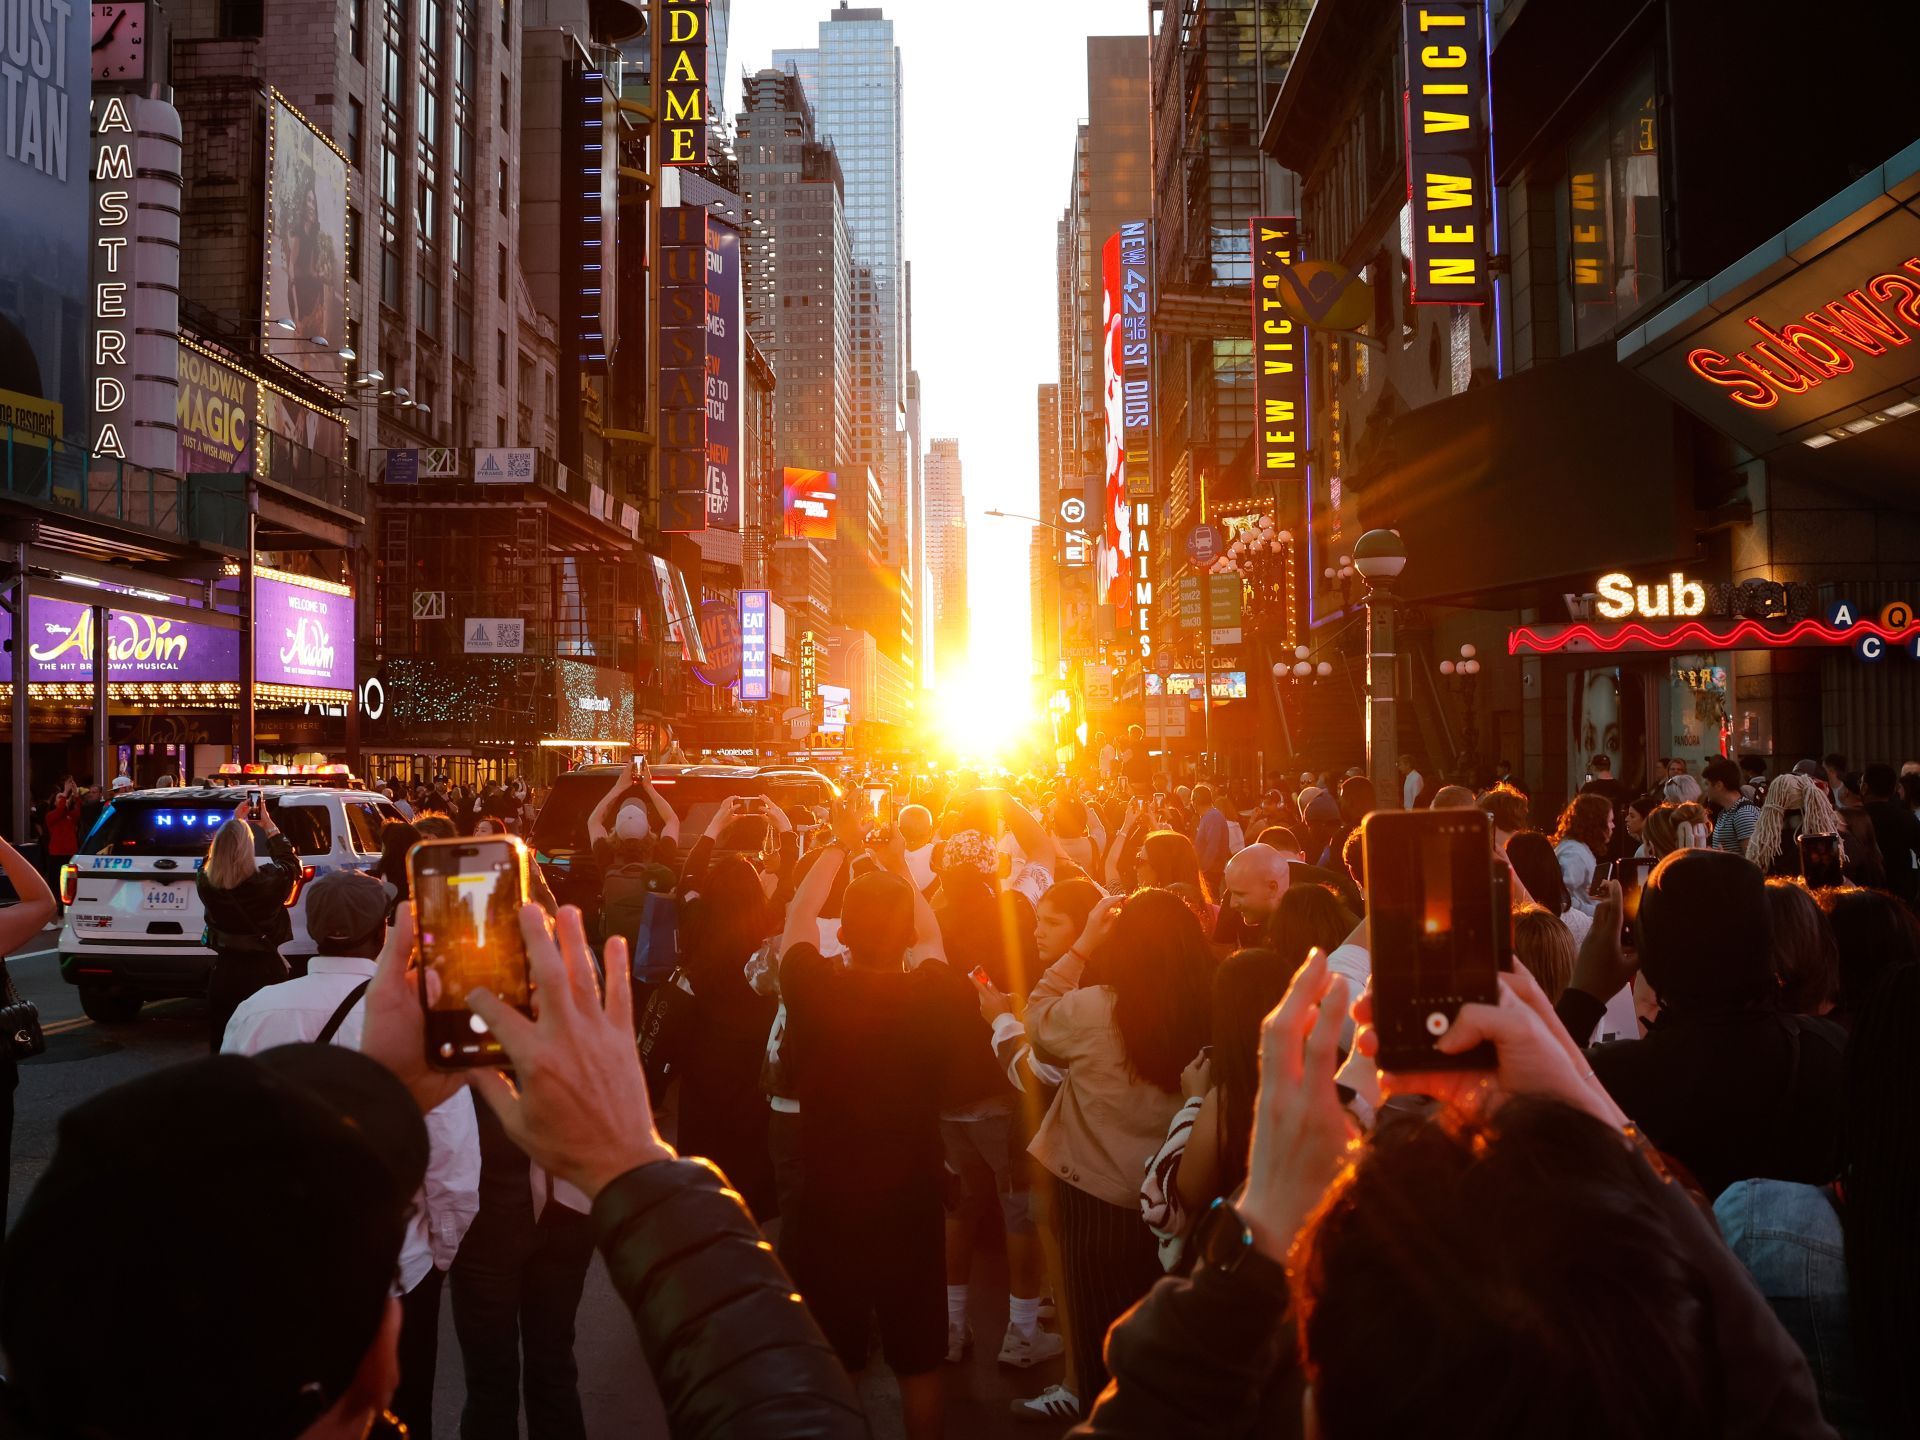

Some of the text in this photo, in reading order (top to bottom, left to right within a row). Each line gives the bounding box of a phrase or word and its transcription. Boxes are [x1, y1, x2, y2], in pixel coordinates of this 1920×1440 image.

[102, 6, 113, 16] 12
[0, 0, 71, 88] UST
[131, 37, 142, 45] 3
[102, 67, 110, 78] 6
[663, 0, 702, 161] DAME
[2, 60, 68, 183] TAN
[1426, 173, 1475, 284] NEW
[1122, 222, 1146, 265] NEW
[1687, 257, 1920, 408] Subwa
[178, 350, 246, 405] ROADWAY
[717, 379, 728, 401] TO
[1266, 399, 1296, 469] NEW
[288, 596, 319, 614] WELCOME
[743, 612, 765, 628] EAT
[1834, 605, 1906, 628] A Q
[743, 650, 765, 662] PLAY
[1862, 637, 1881, 657] C
[803, 646, 813, 711] EMPIRE
[1088, 685, 1110, 697] 25
[1674, 735, 1700, 746] PANDORA
[92, 857, 133, 869] NYPD
[147, 891, 175, 903] 4420
